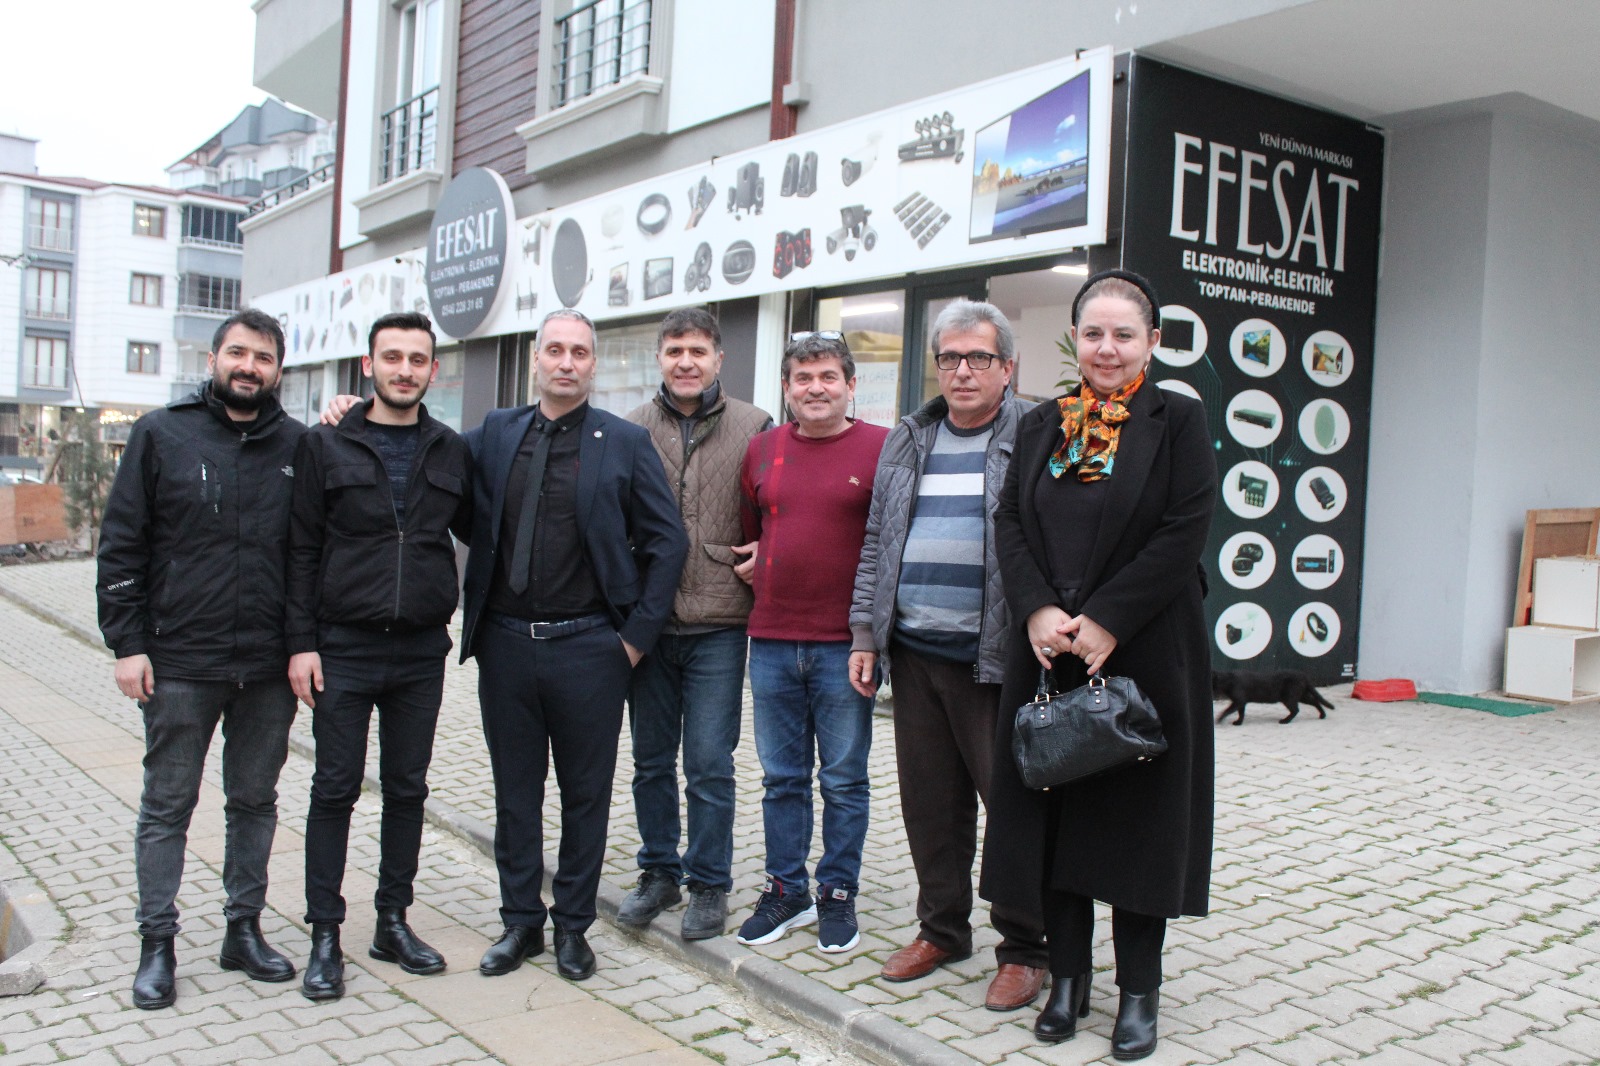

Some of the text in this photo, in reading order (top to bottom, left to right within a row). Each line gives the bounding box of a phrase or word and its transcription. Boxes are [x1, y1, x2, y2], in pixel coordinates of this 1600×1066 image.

[1259, 131, 1353, 169] YENİ DÜNYA MARKASI
[1169, 132, 1359, 272] EFESAT
[436, 207, 498, 263] EFESAT
[1182, 250, 1334, 297] ELEKTRONİK-ELEKTRİK
[1199, 281, 1316, 315] TOPTAN-PERAKENDE
